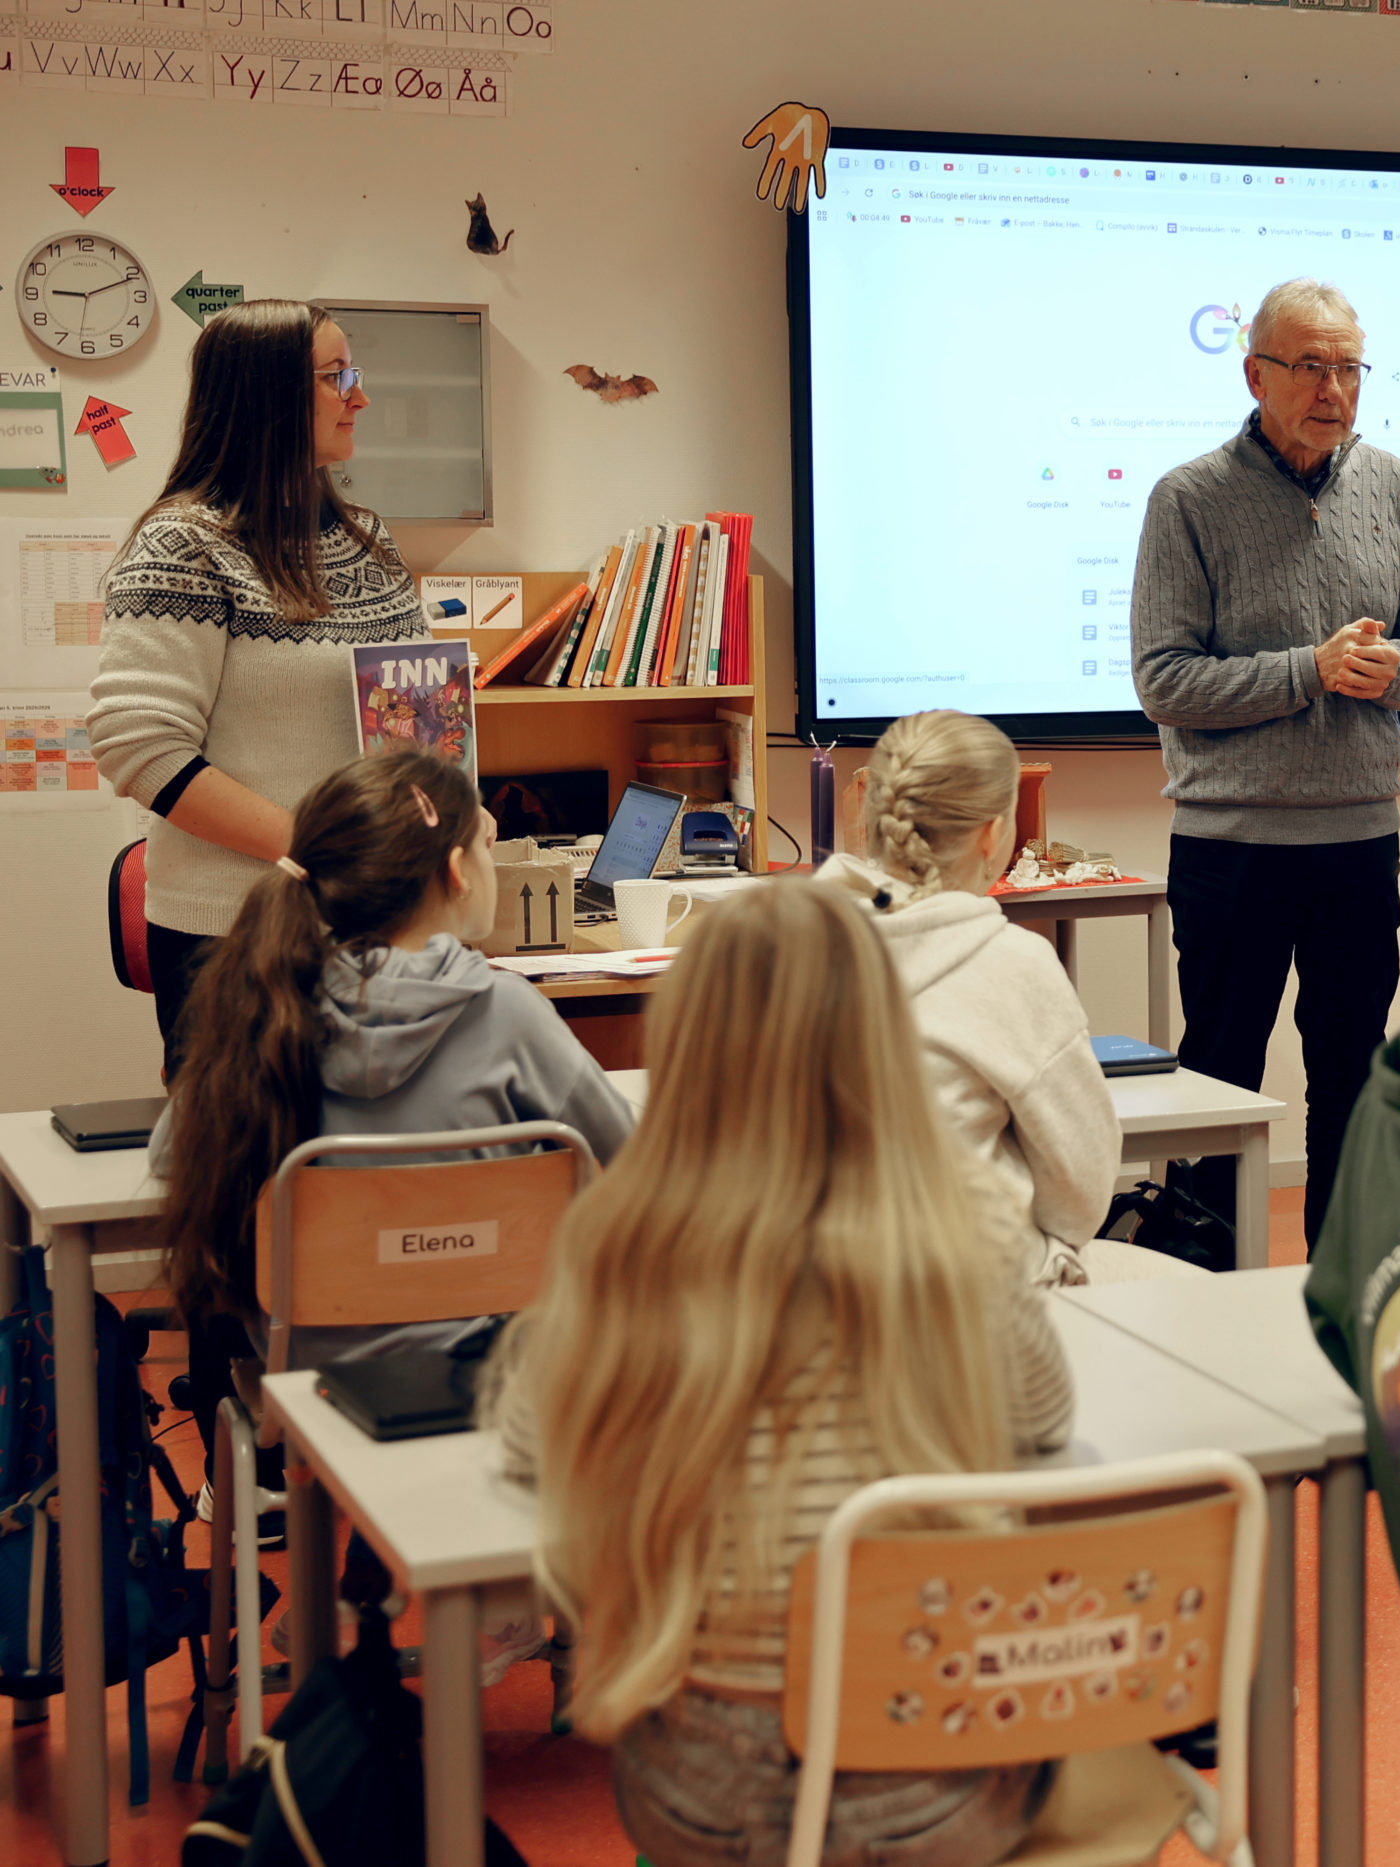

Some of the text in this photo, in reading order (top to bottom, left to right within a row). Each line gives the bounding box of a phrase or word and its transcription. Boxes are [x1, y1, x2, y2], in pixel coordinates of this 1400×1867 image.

[391, 0, 444, 31] Mm
[454, 3, 497, 35] Nn
[506, 6, 552, 38] Oo
[30, 41, 78, 75] Vv
[85, 46, 142, 79] Ww
[153, 49, 195, 83] Xx
[220, 54, 265, 99] Yy
[280, 59, 323, 92] Zz
[333, 63, 382, 95] Ææ
[395, 67, 442, 99] Øø
[456, 68, 497, 102] Åå
[58, 186, 104, 198] o'clock
[909, 190, 923, 199] Søk
[930, 191, 958, 202] Google
[960, 192, 977, 200] eller
[979, 192, 996, 201] skriv
[998, 193, 1010, 202] inn
[1012, 195, 1023, 203] en
[1024, 194, 1070, 204] nettadresse
[914, 215, 944, 224] YouTube
[47, 244, 61, 258] 11
[75, 238, 94, 252] 12
[110, 247, 117, 260] 1
[29, 262, 46, 276] 10
[126, 266, 140, 280] 2
[25, 287, 38, 301] 9
[134, 290, 147, 304] 3
[186, 285, 240, 300] quarter
[199, 299, 229, 314] past
[34, 312, 47, 326] 8
[127, 315, 140, 328] 4
[55, 331, 69, 345] 7
[110, 334, 123, 348] 5
[81, 340, 95, 355] 6
[86, 404, 110, 421] half
[91, 415, 118, 436] past
[1090, 417, 1106, 427] Søk
[1113, 418, 1144, 429] Google
[1146, 418, 1164, 427] eller
[1166, 418, 1185, 428] skriv
[1027, 500, 1069, 510] Google Disk
[1100, 500, 1131, 509] YouTube
[1077, 556, 1119, 566] Google Disk
[426, 578, 467, 590] Viskelær
[475, 578, 520, 592] Gråblyant
[381, 656, 449, 689] INN
[401, 1231, 475, 1254] Elena
